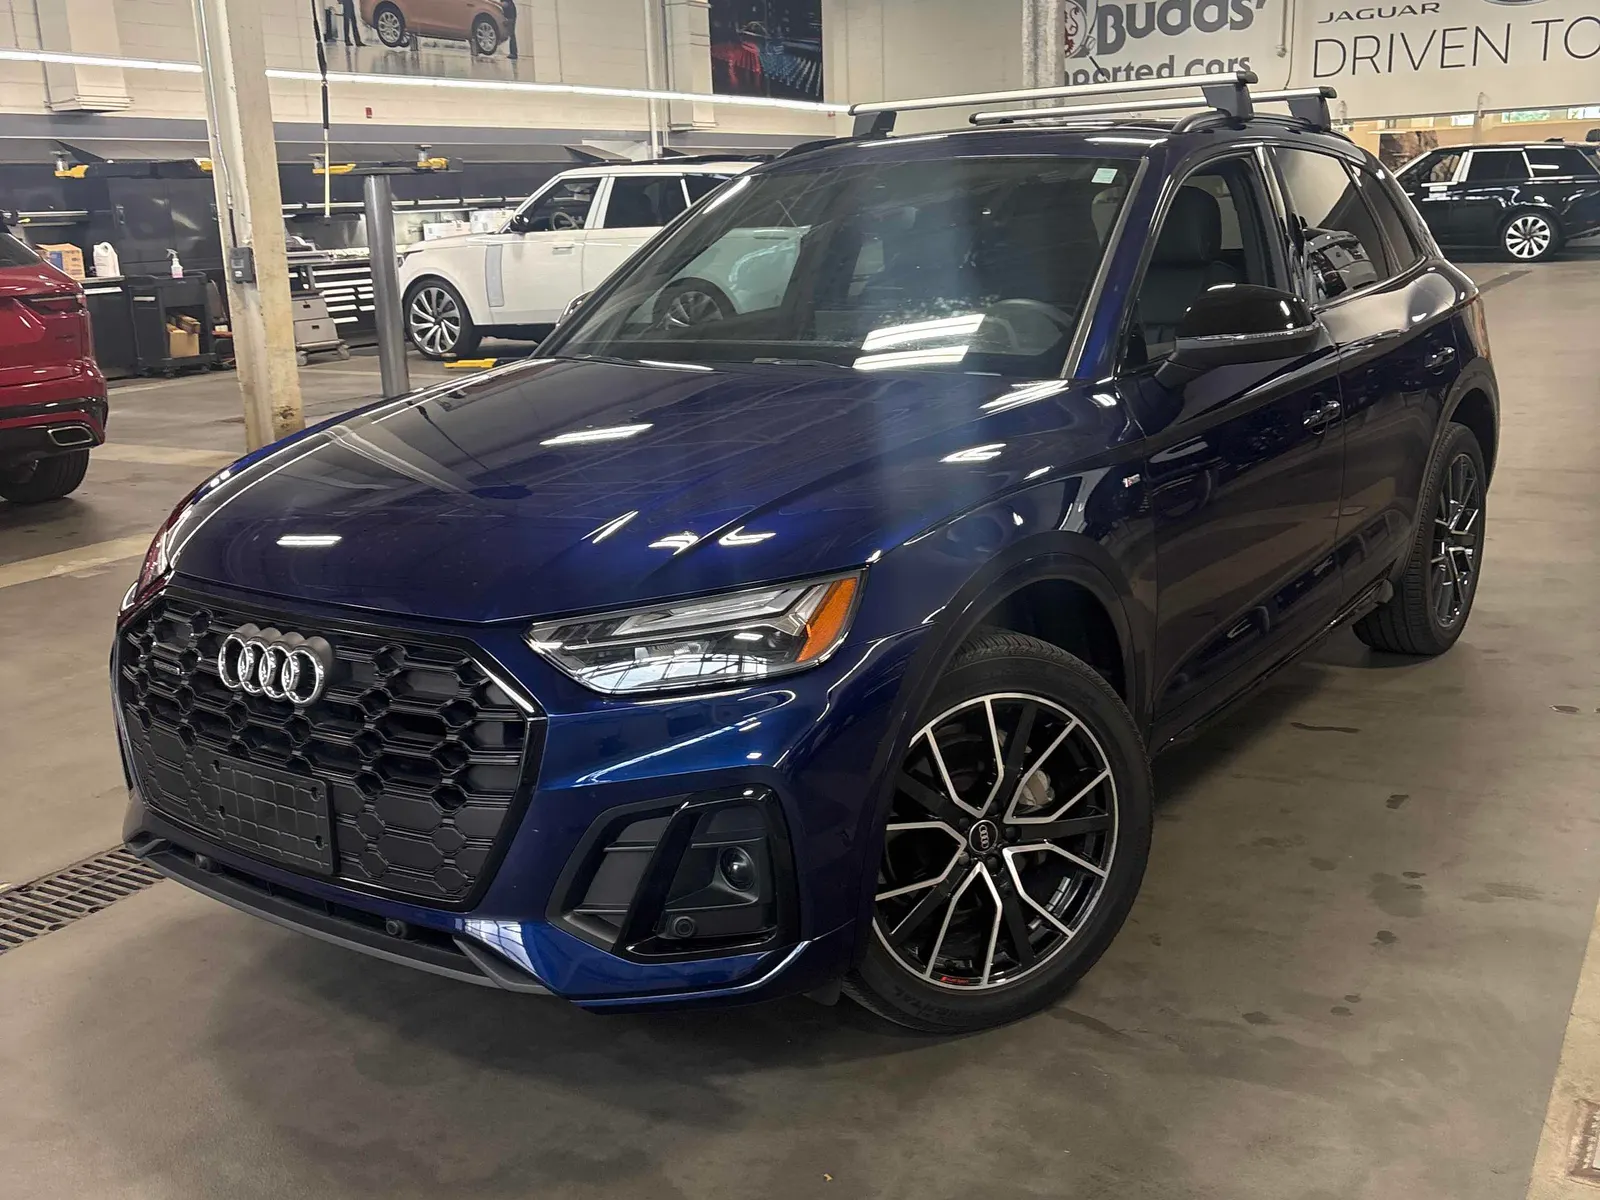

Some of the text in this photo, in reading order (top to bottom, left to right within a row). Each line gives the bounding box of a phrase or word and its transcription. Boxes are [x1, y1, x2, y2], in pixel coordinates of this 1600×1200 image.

[1318, 2, 1440, 24] JAGUAR
[1313, 15, 1600, 78] DRIVEN TO
[1064, 55, 1251, 86] ported cars
